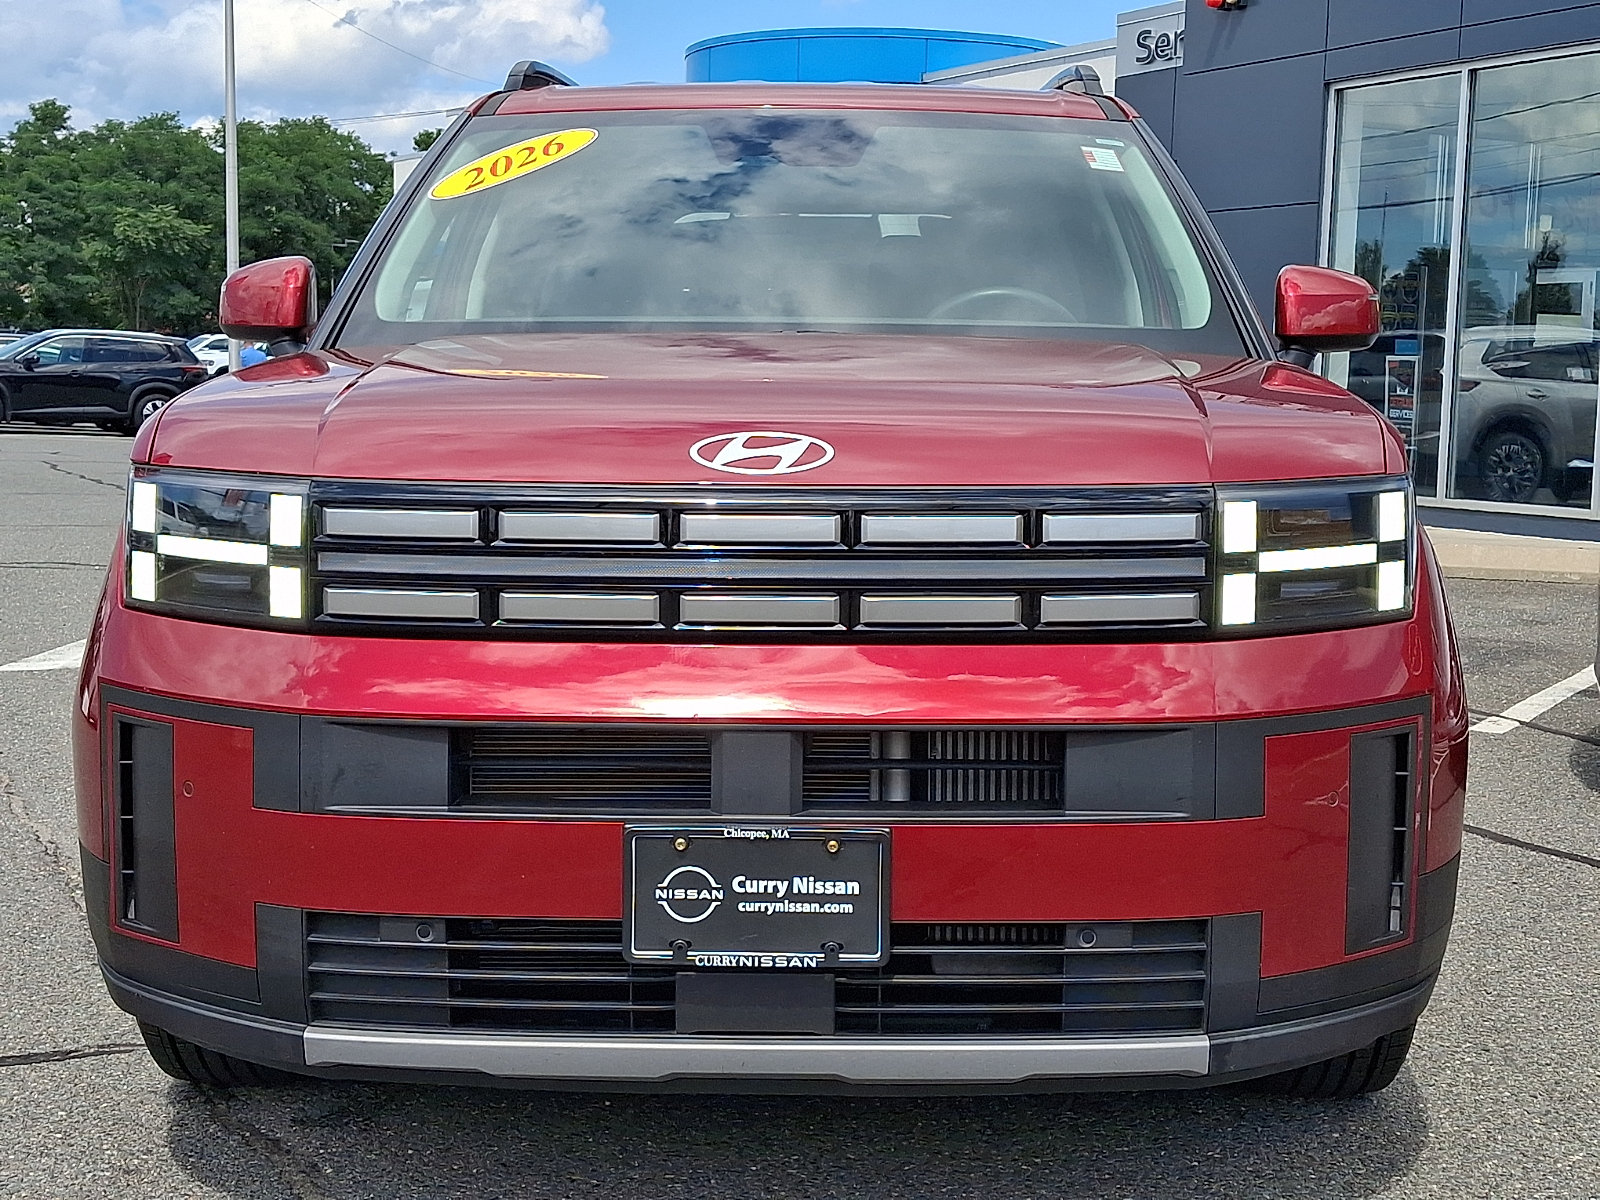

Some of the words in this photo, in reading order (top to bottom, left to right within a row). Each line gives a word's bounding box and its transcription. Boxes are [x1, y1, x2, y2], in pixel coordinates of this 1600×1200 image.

[464, 135, 564, 190] 2026
[724, 828, 770, 840] Chicopee,
[771, 829, 790, 839] MA
[655, 888, 724, 900] NISSAN
[731, 875, 790, 898] Curry
[792, 876, 860, 895] Nissan
[738, 899, 854, 916] currynissan.com
